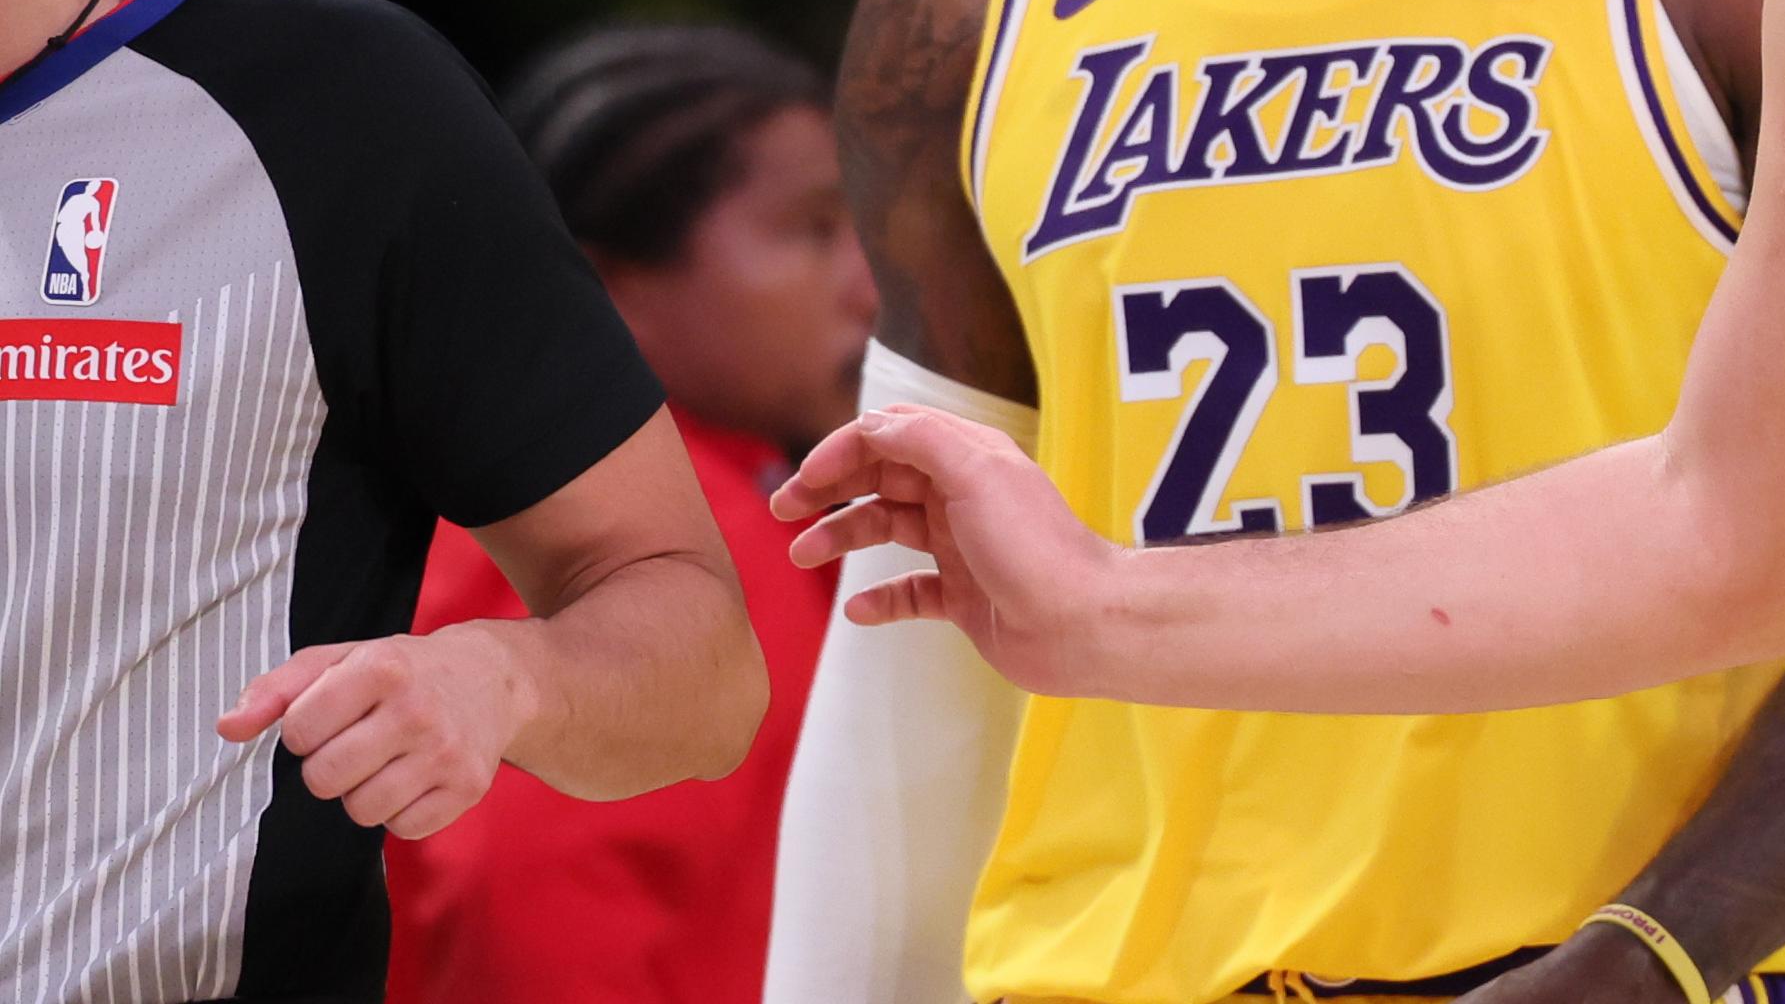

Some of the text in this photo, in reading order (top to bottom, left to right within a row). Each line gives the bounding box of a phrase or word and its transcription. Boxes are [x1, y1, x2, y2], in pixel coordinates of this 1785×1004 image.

[1021, 33, 1553, 266] LAKERS
[49, 272, 77, 295] NBA
[0, 334, 173, 384] mirates
[1112, 261, 1460, 549] 23
